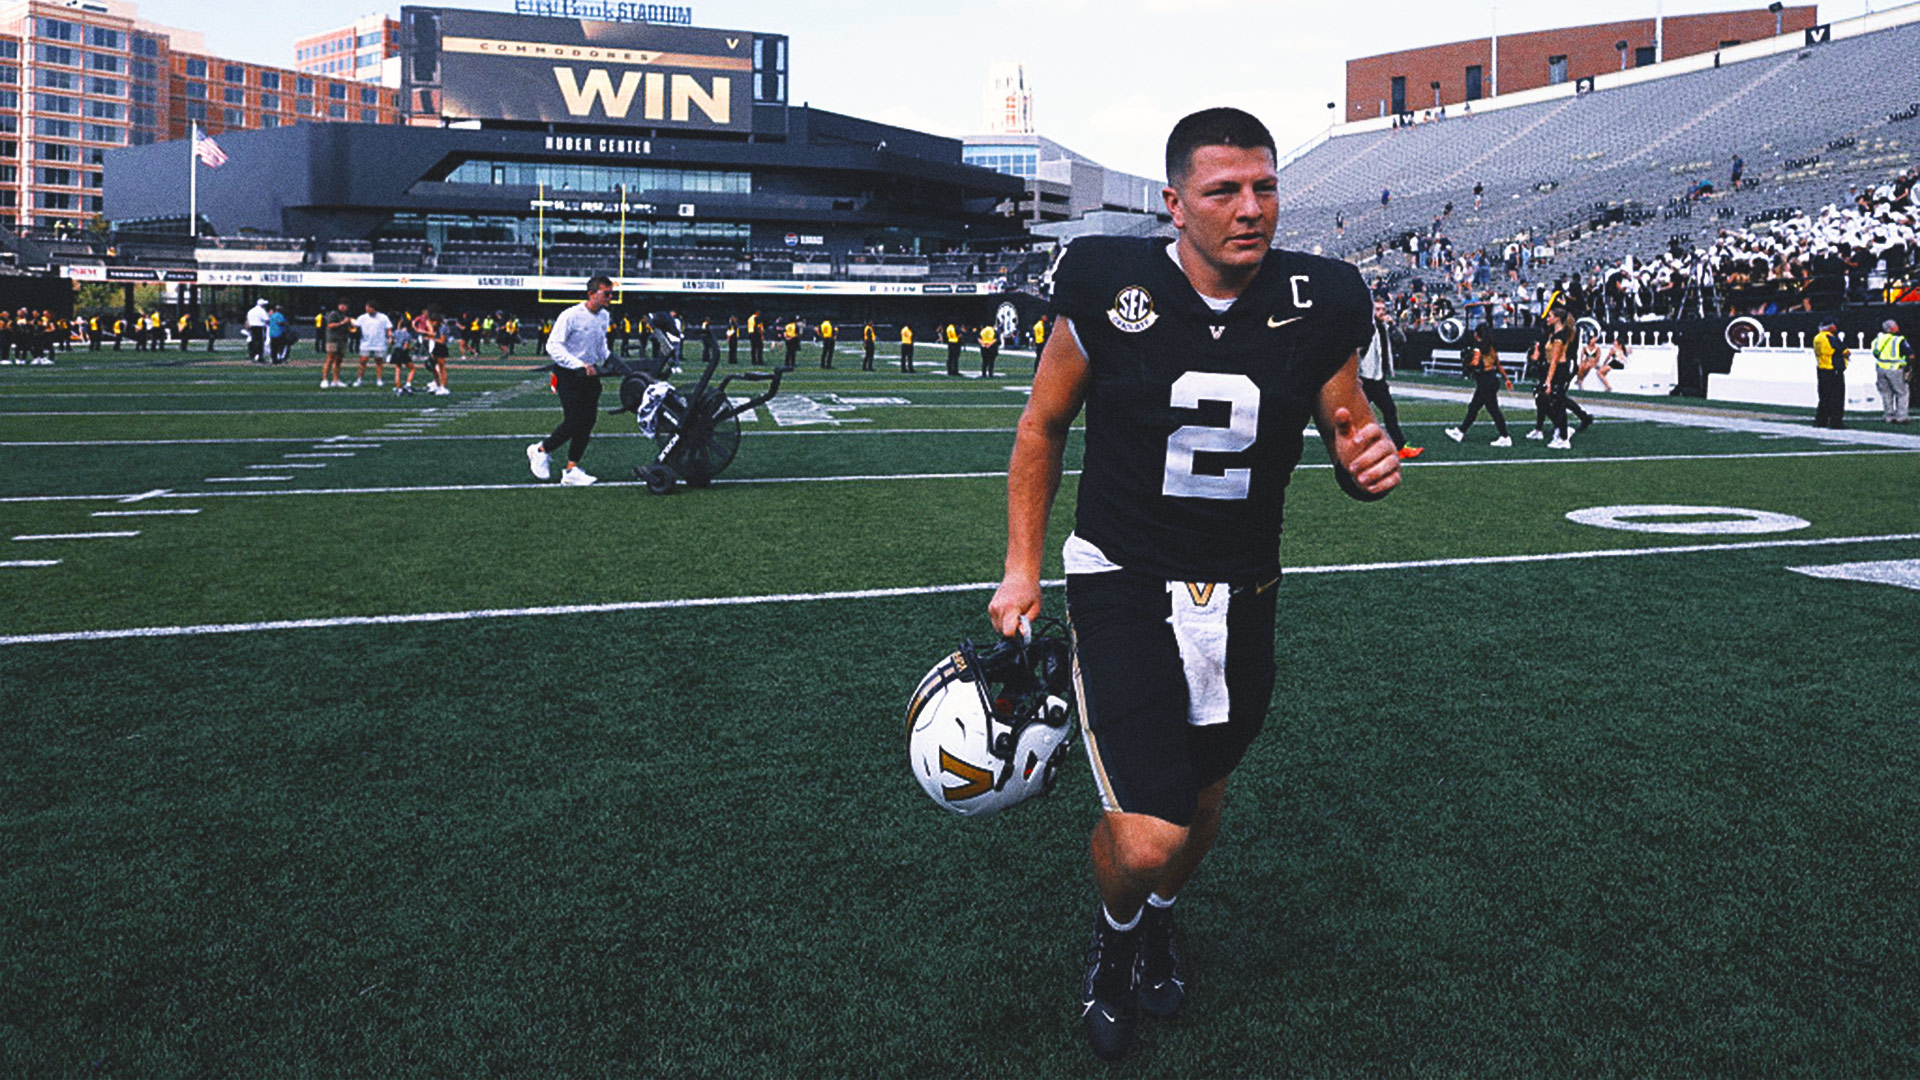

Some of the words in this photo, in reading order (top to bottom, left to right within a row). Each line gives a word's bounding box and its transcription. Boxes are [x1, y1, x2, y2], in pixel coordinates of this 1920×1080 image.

[617, 2, 692, 24] STADIUM
[553, 67, 730, 124] WIN
[599, 138, 651, 154] CENTER
[1119, 289, 1149, 320] SEC
[1290, 275, 1313, 308] C
[1162, 370, 1261, 499] 2
[939, 745, 995, 801] V
